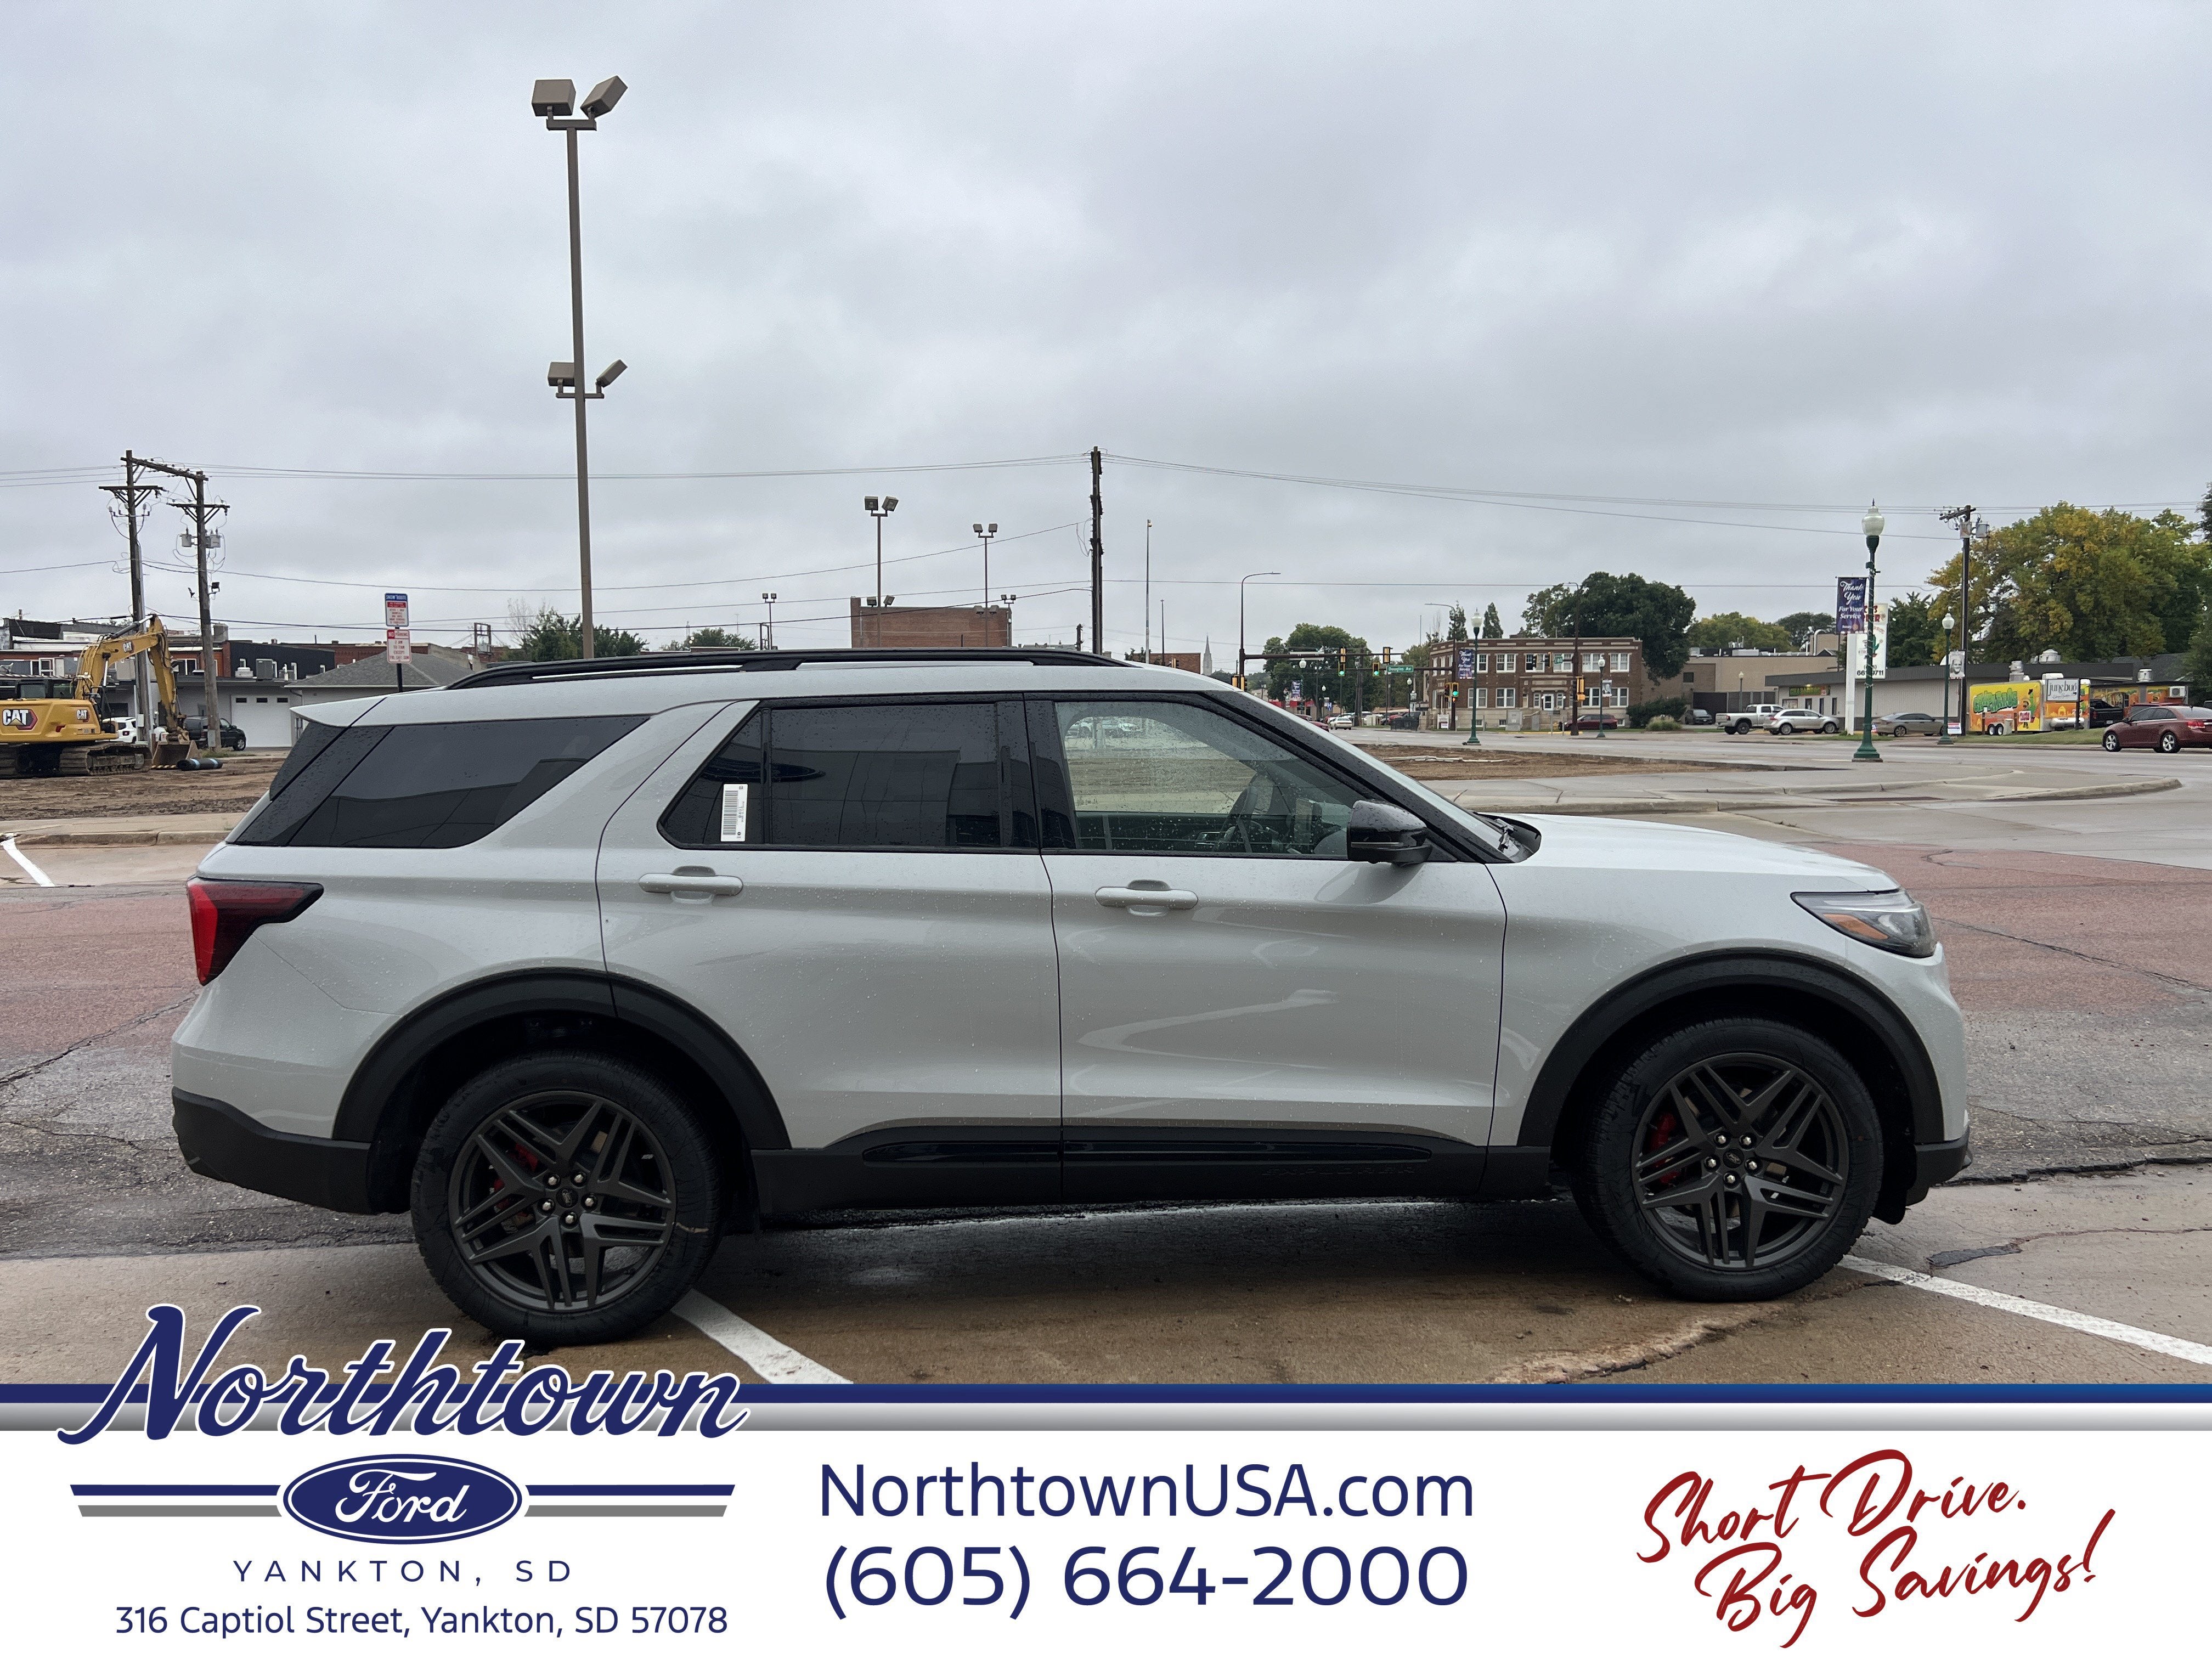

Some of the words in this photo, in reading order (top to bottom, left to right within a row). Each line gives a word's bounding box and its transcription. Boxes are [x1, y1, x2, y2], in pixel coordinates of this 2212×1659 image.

[1839, 581, 1864, 592] Thank
[1844, 592, 1861, 605] You
[3, 709, 29, 726] CAT
[77, 709, 88, 720] CAT
